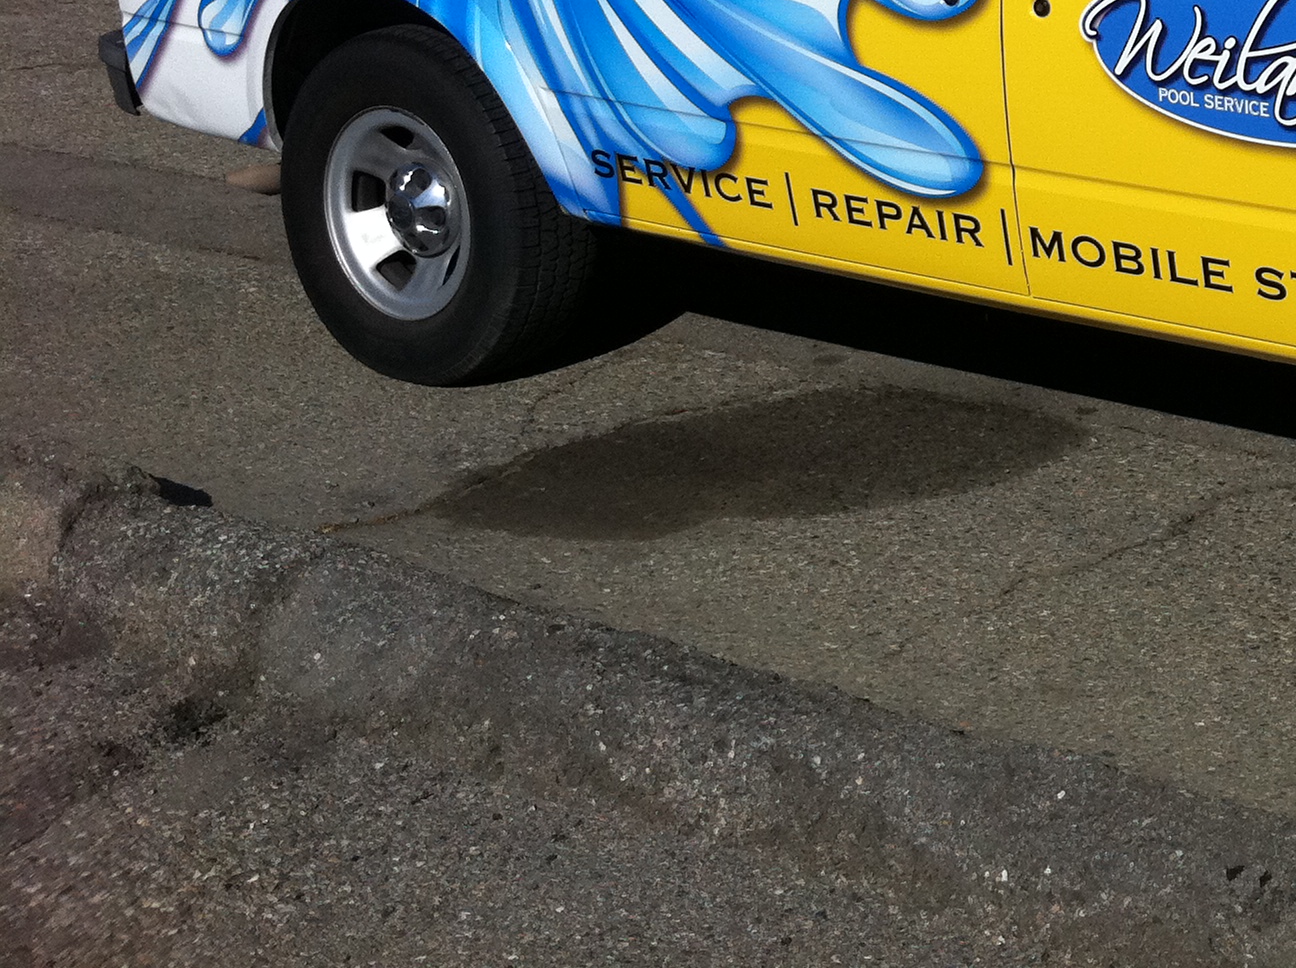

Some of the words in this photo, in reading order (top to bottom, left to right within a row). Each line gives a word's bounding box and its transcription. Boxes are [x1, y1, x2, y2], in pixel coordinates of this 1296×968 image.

[1158, 86, 1201, 109] POOL
[1204, 93, 1270, 118] SERVICE
[590, 149, 773, 209] SERVICE
[810, 188, 985, 249] REPAIR
[1028, 226, 1234, 293] MOBILE
